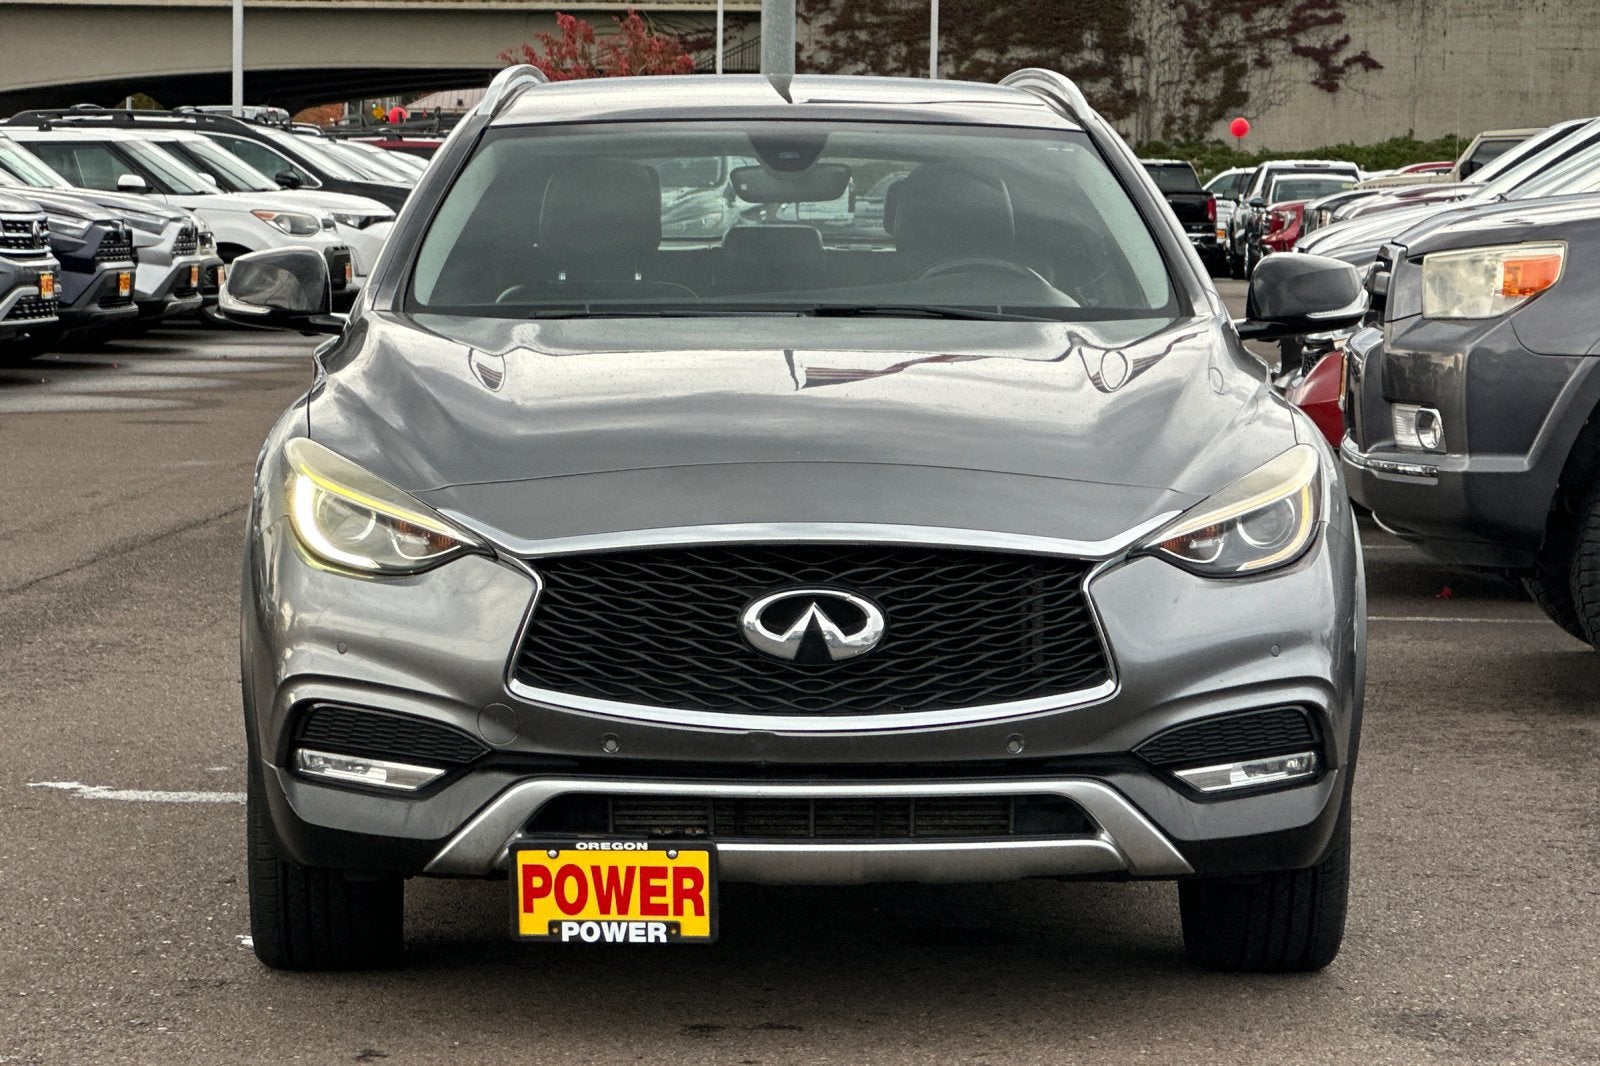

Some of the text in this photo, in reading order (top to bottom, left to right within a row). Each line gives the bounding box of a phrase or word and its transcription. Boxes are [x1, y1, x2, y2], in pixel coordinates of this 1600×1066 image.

[575, 842, 648, 850] OREGON
[522, 863, 705, 916] POWER
[561, 921, 667, 942] POWER
